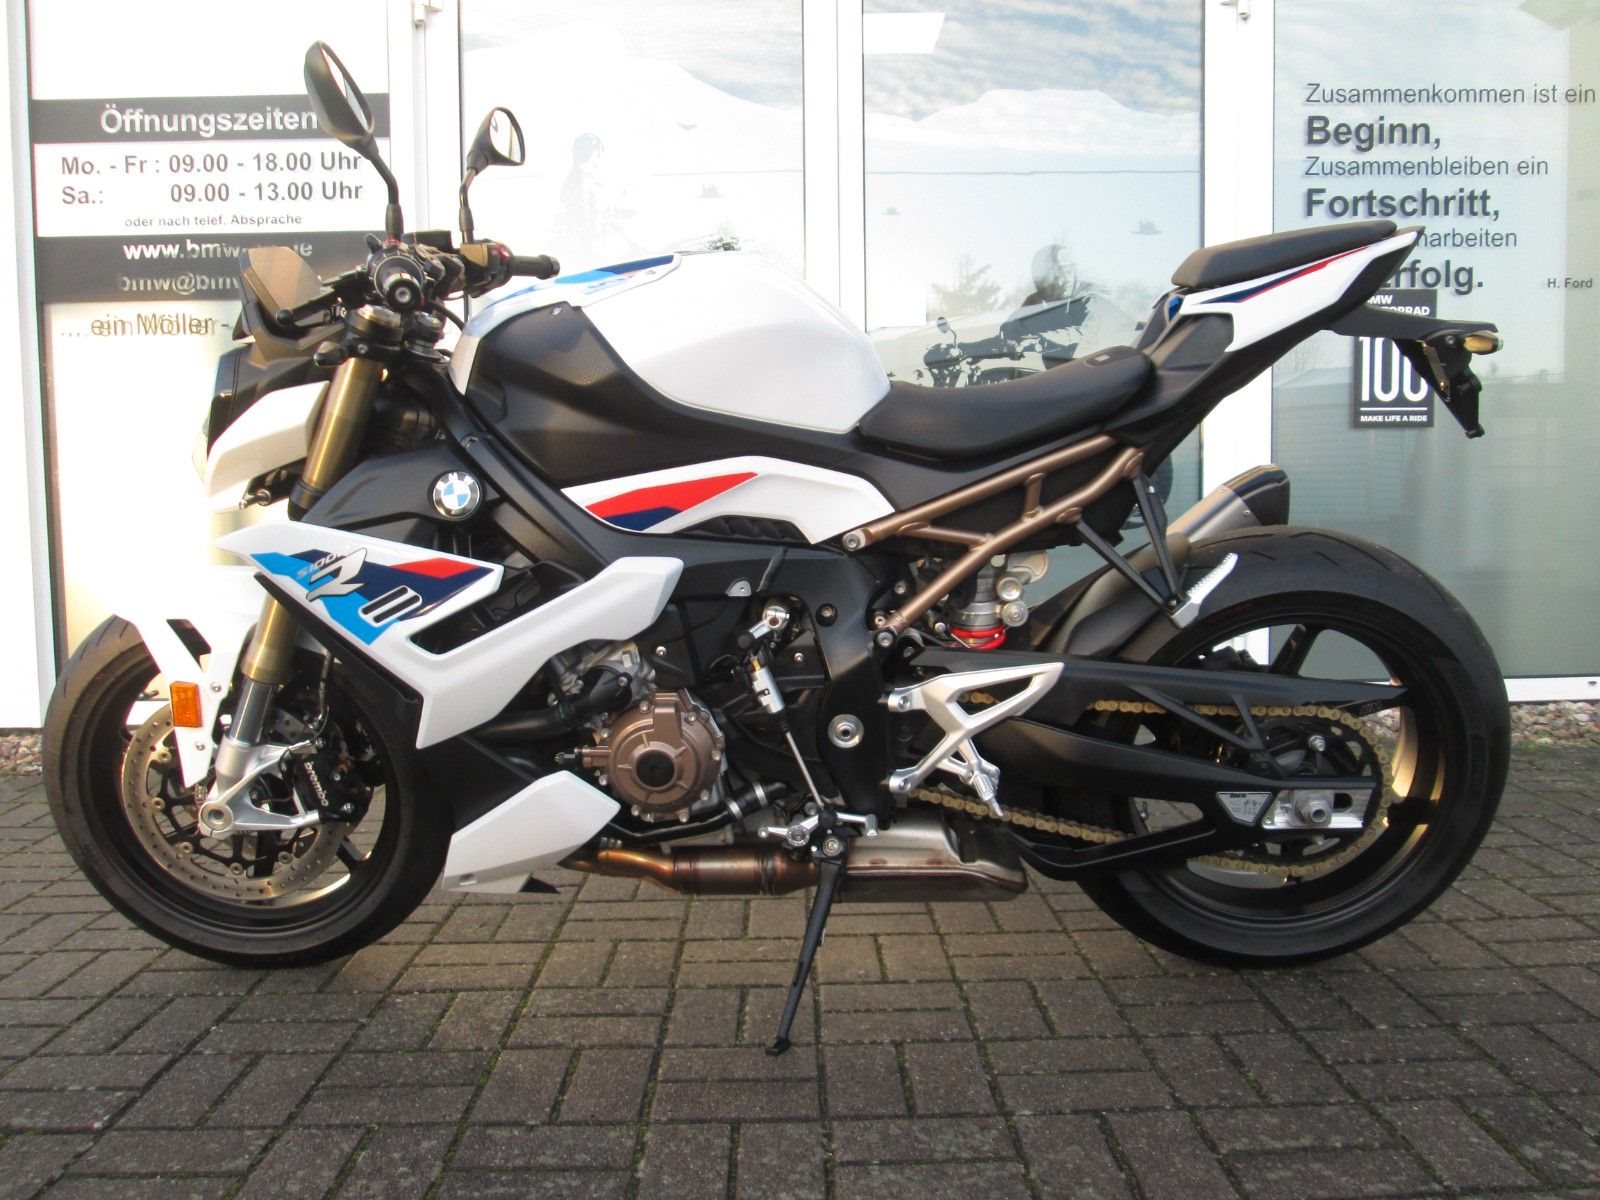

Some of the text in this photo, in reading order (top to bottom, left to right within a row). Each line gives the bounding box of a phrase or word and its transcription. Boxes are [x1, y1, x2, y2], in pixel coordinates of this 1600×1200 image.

[1304, 82, 1596, 104] Zusammenkommen ist ein
[100, 104, 318, 139] Öffnungszeiten
[1306, 115, 1441, 152] Beginn,
[61, 155, 100, 176] Mo.
[168, 153, 229, 174] 09.00
[252, 152, 312, 172] 18.00
[320, 150, 361, 171] Uhr
[1304, 155, 1549, 176] Zusammenbleiben ein
[61, 186, 104, 205] Sa.:
[170, 183, 229, 203] 09.00
[254, 181, 313, 201] 13.00
[321, 180, 363, 200] Uhr
[1306, 188, 1500, 221] Fortschritt,
[125, 216, 154, 227] oder
[158, 215, 190, 226] nach
[231, 213, 302, 227] Absprache
[1416, 228, 1518, 248] narbeiten
[1547, 277, 1593, 289] H. Ford
[1367, 295, 1393, 304] MW
[303, 762, 329, 806] brembo
